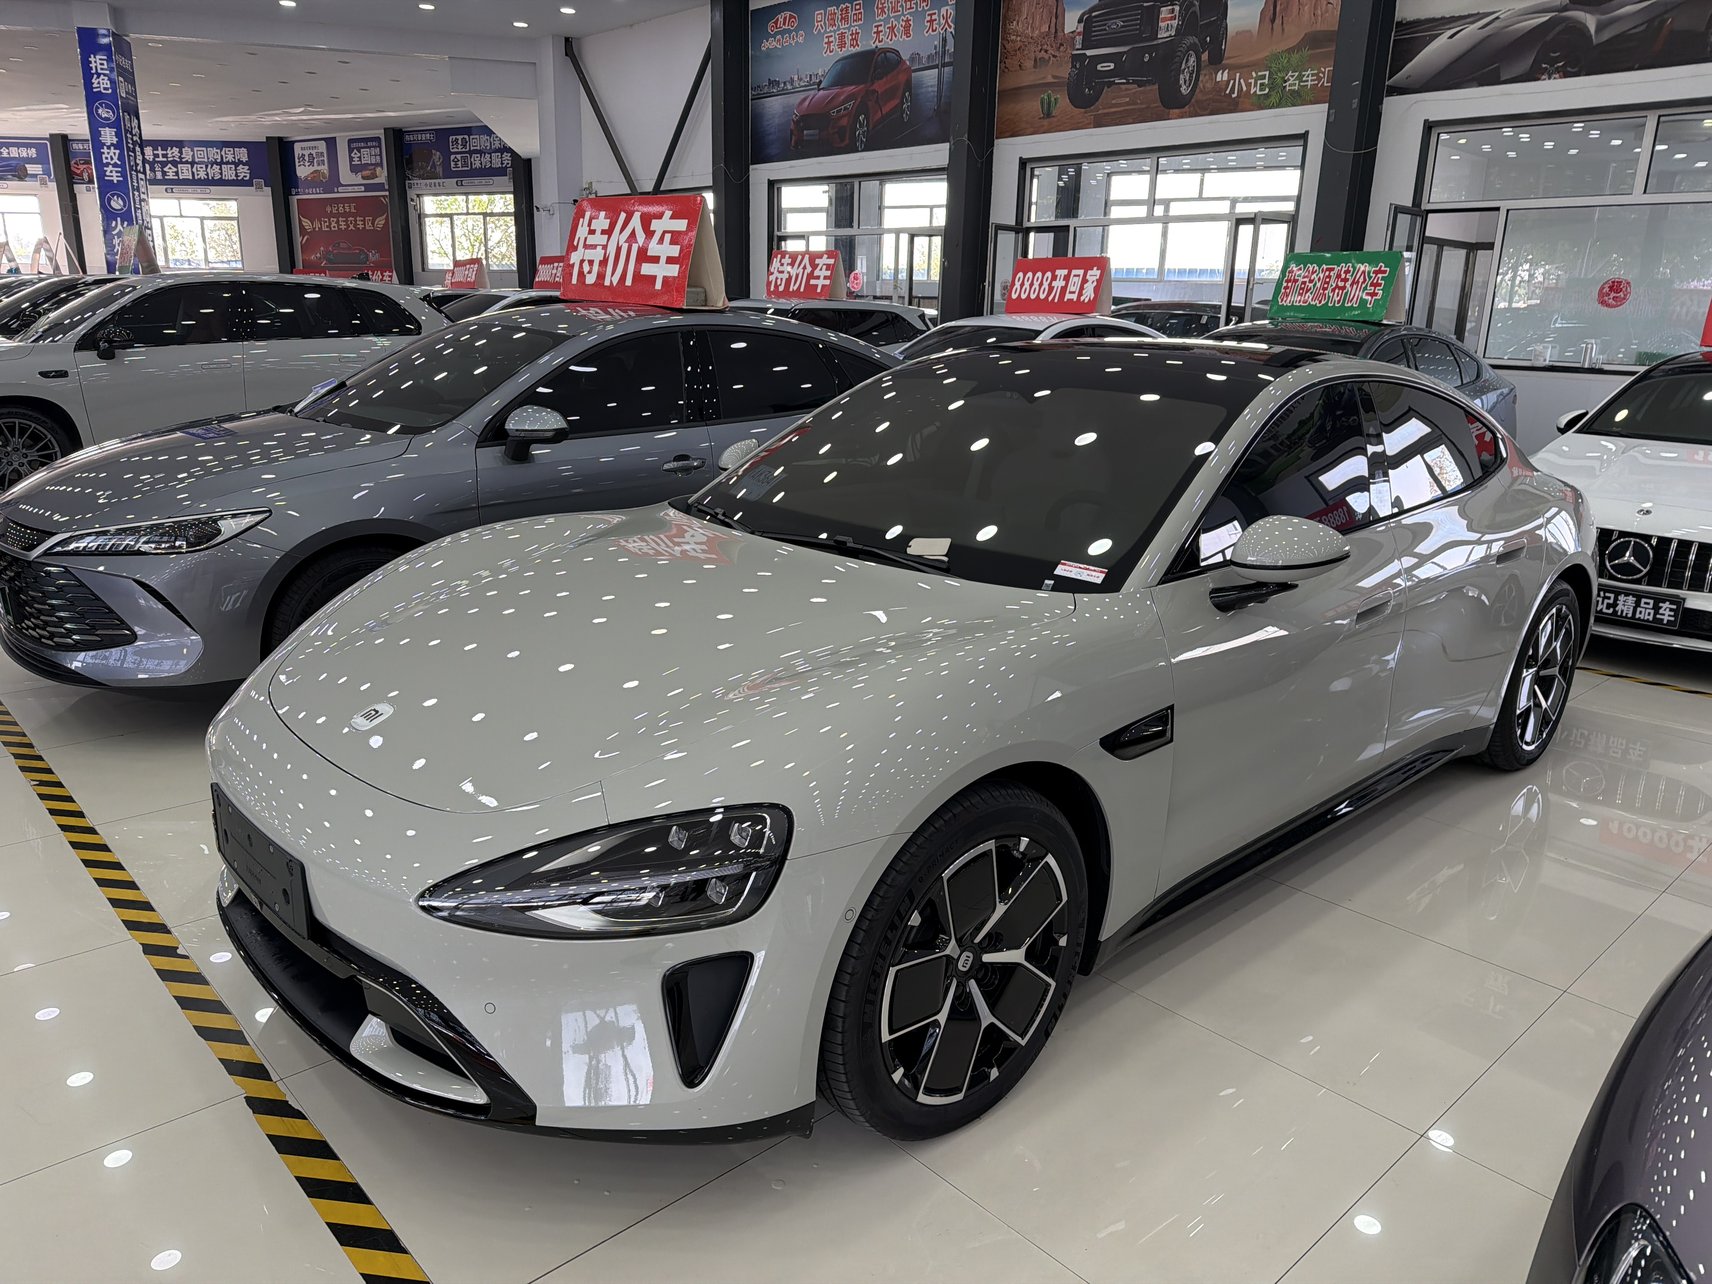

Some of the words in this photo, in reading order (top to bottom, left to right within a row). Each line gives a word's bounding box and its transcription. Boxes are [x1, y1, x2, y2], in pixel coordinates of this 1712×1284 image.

[814, 2, 864, 33] 只做精品
[823, 29, 861, 56] 无事故
[872, 15, 912, 46] 无水淹
[89, 54, 112, 94] 拒绝
[1284, 67, 1334, 92] 名车汇
[0, 146, 37, 158] 全国保修
[98, 127, 123, 184] 事故车
[313, 216, 374, 231] 小记名车交车区
[569, 210, 688, 290] 特价车
[769, 254, 835, 293] 特价车
[1011, 266, 1101, 303] 8888开回家
[1278, 263, 1389, 307] 新能源特价车
[1596, 591, 1677, 624] 记精品车
